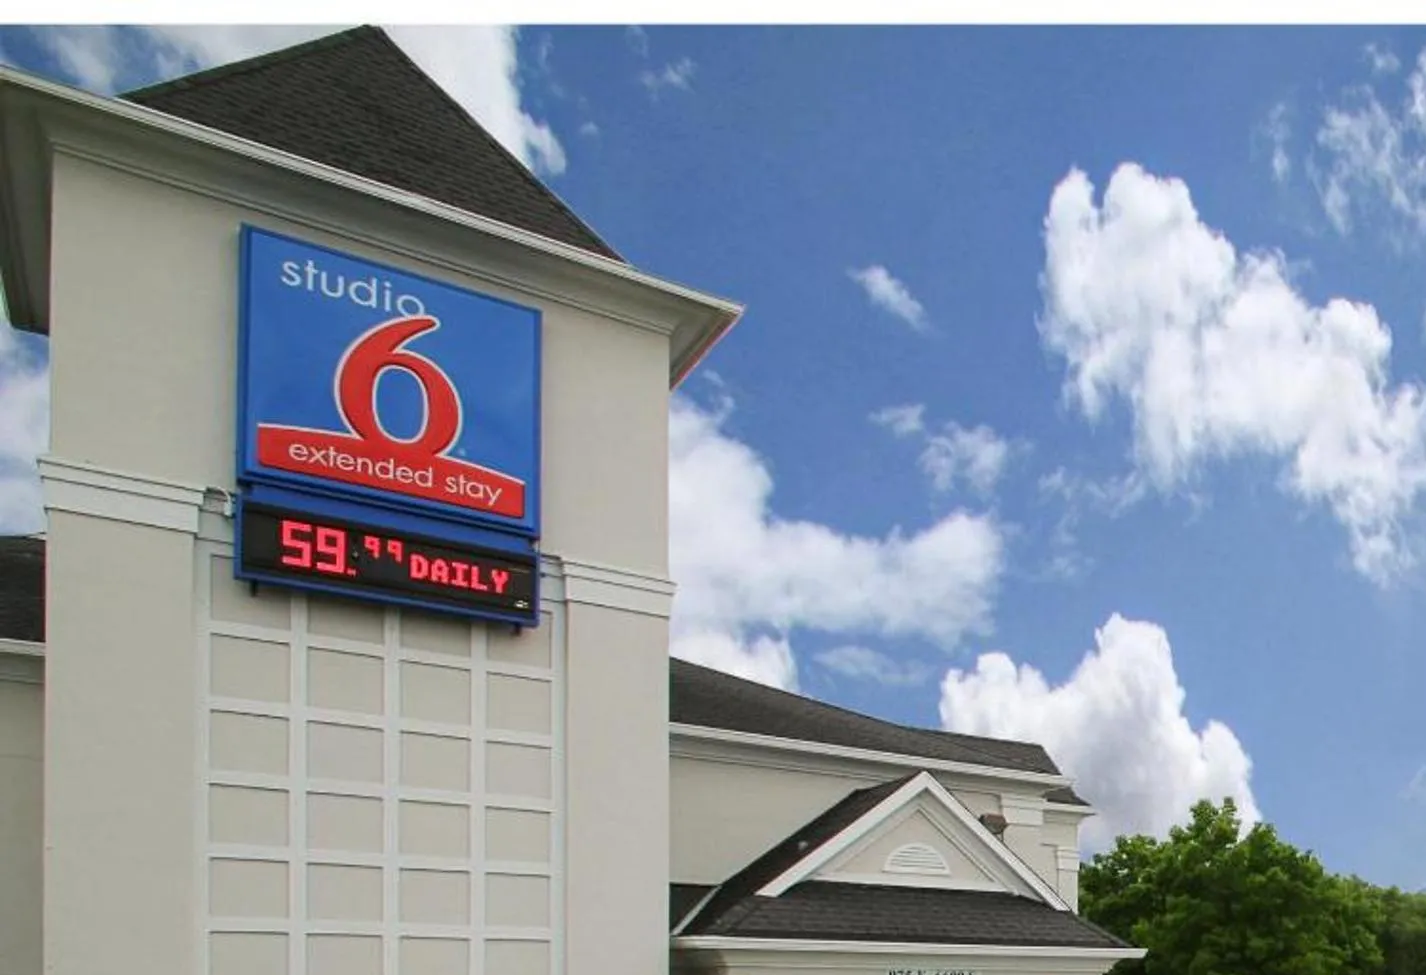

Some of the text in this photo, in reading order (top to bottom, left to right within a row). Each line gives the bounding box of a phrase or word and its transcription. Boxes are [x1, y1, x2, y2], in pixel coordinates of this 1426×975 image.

[280, 259, 426, 318] studio
[334, 314, 463, 456] 6
[288, 442, 502, 506] extended stay
[409, 553, 509, 593] DAILY
